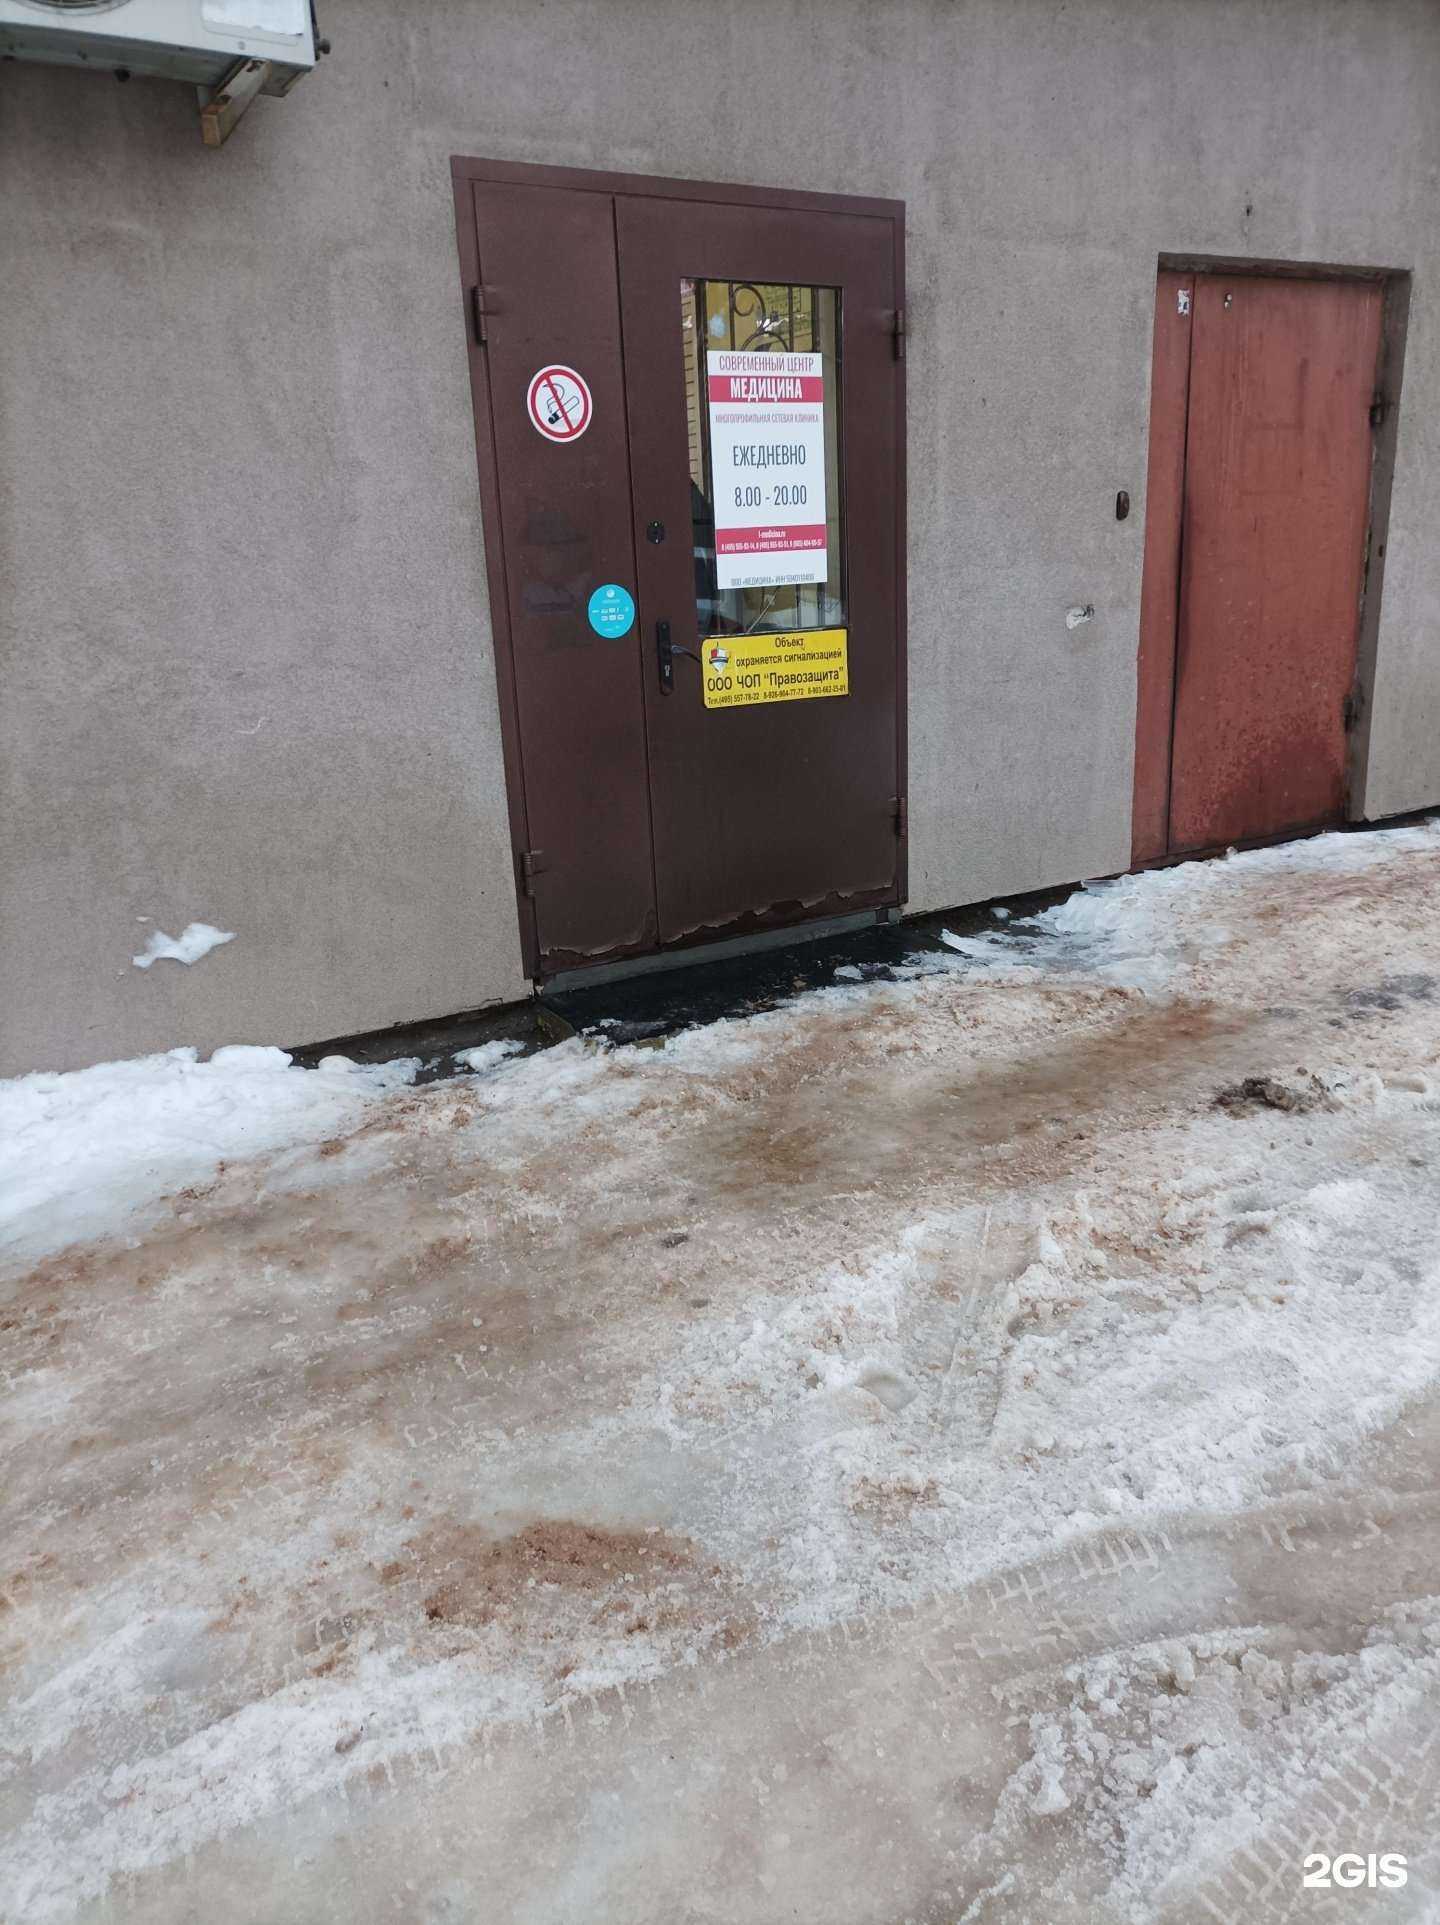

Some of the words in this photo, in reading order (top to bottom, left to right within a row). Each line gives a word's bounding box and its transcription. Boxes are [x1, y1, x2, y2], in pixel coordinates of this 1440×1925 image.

[719, 355, 785, 372] СОВРЕМЕННЫЙ
[787, 356, 814, 374] ЦЕНТР
[730, 377, 803, 402] МЕДИЦИНА
[733, 444, 806, 469] ЕЖЕДНЕВНО
[734, 486, 761, 507] 8.00
[774, 485, 807, 505] 20.00
[775, 637, 805, 648] Объект
[735, 655, 783, 668] охраняется
[784, 647, 842, 663] сигнализацией
[707, 676, 733, 692] ООО
[736, 673, 761, 689] ЧОП
